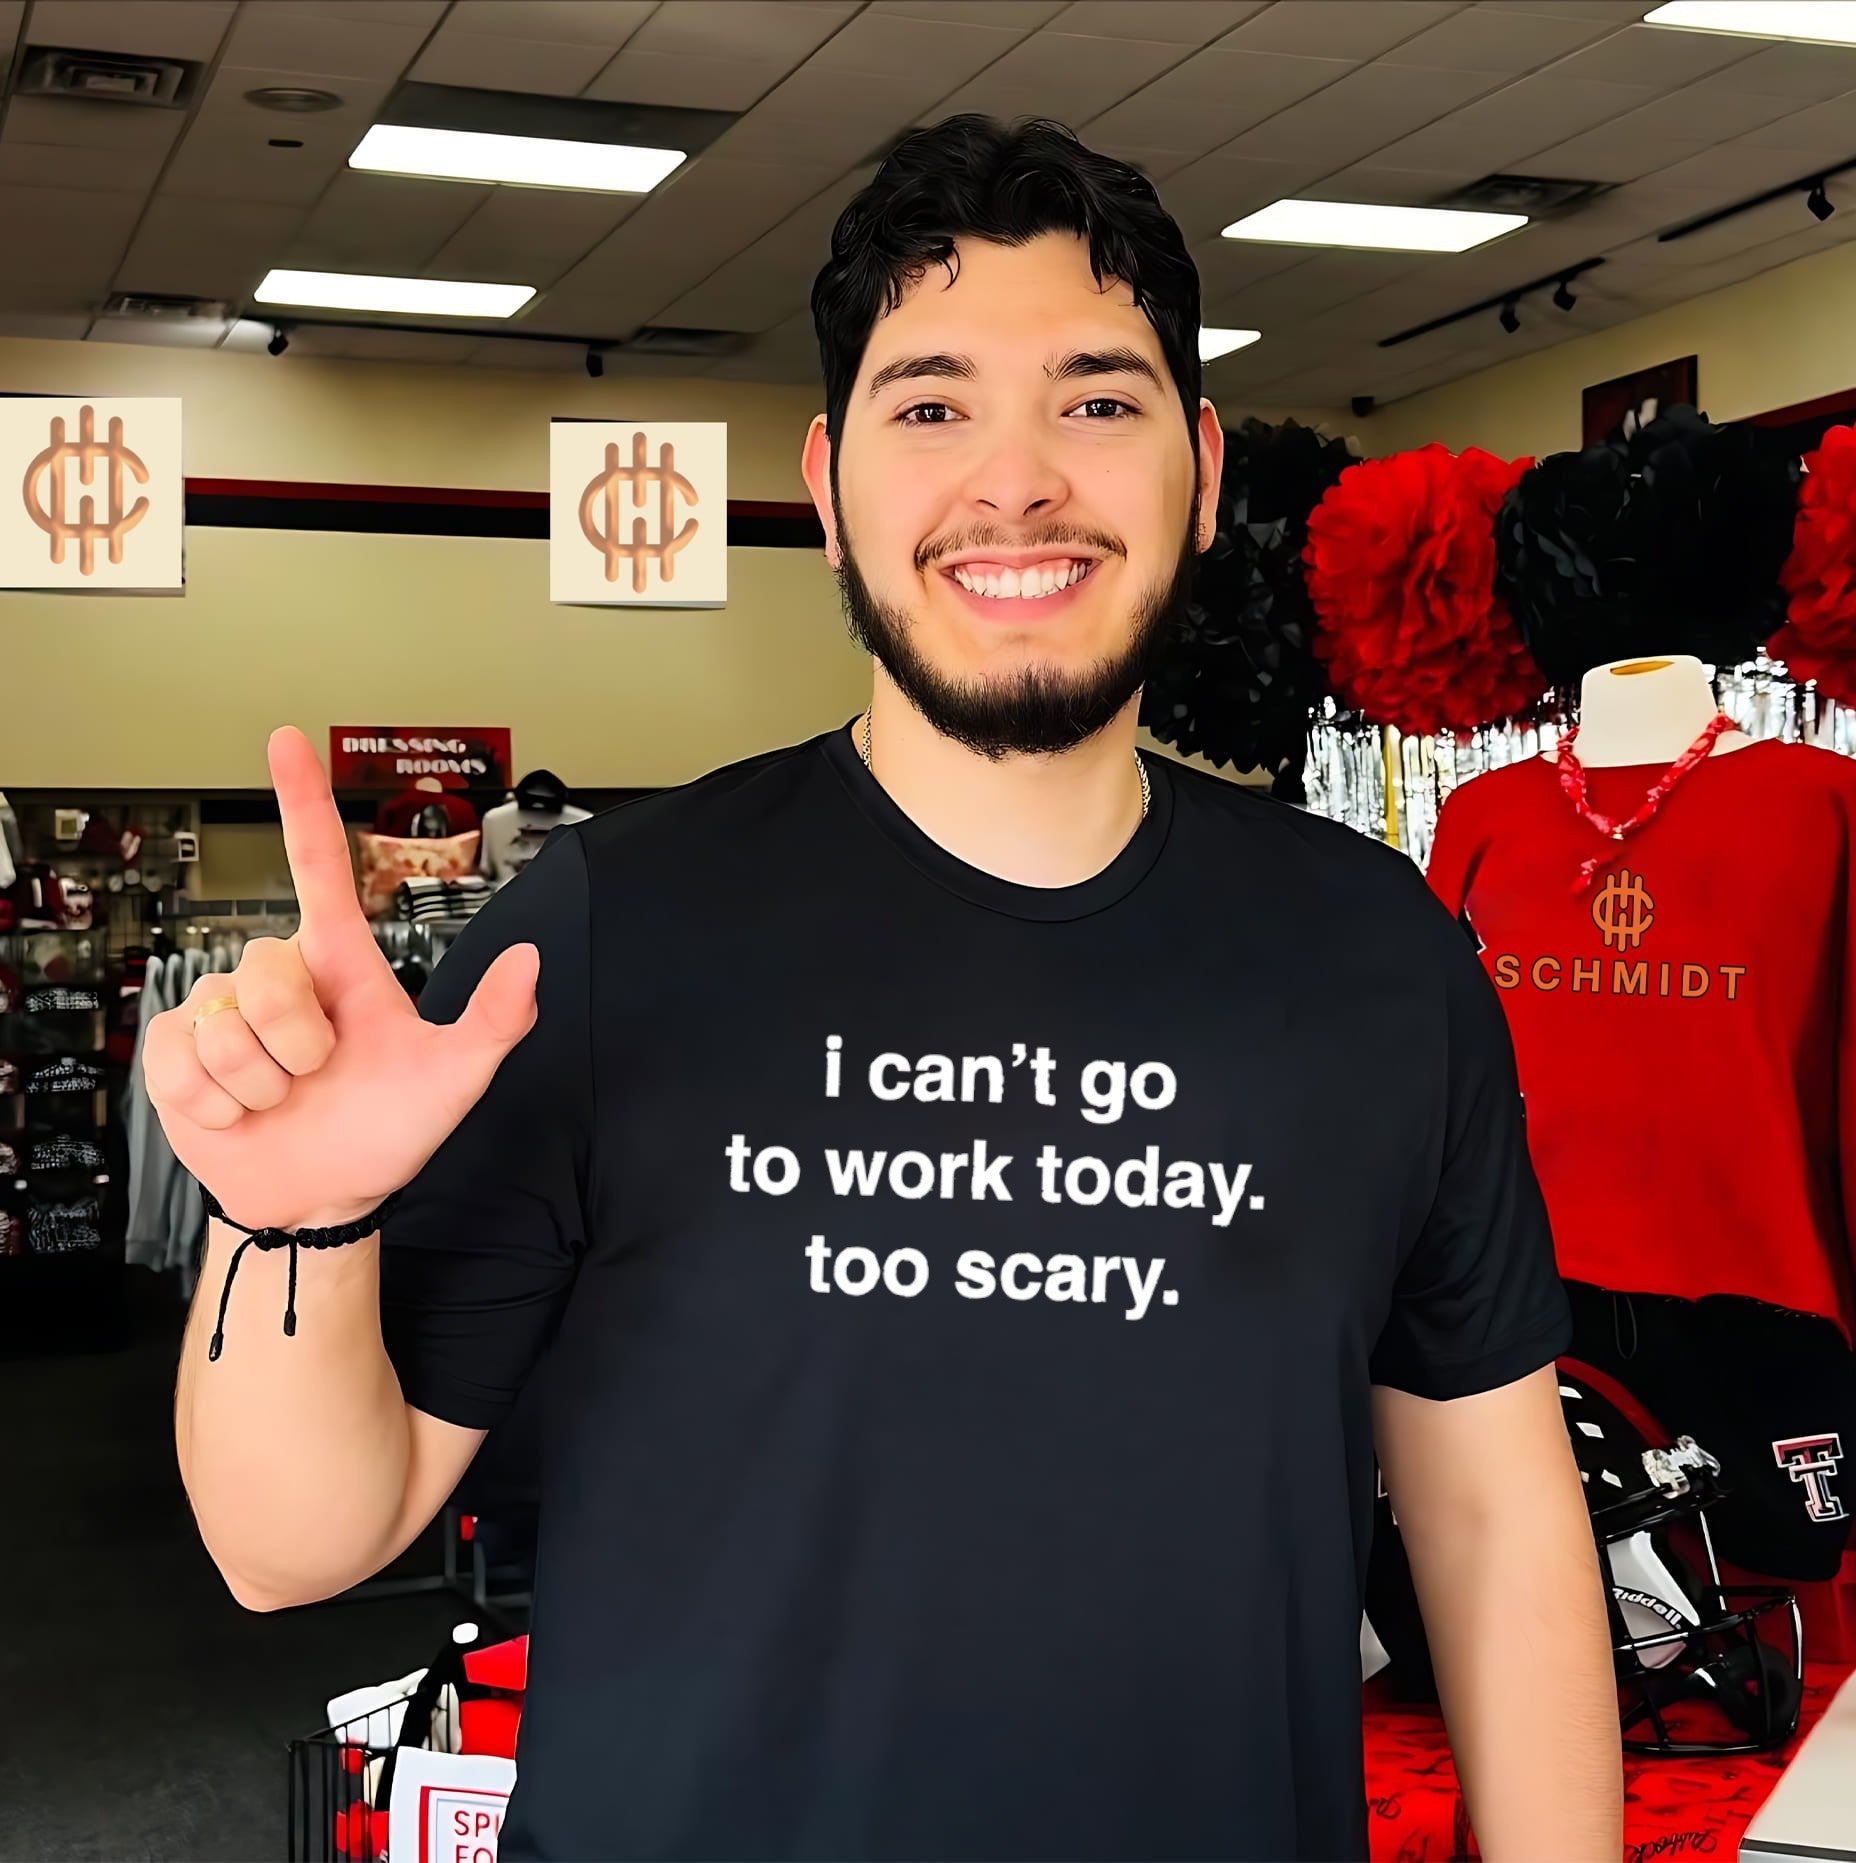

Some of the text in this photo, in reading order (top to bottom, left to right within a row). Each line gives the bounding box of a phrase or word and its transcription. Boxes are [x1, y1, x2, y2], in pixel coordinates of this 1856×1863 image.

[1494, 954, 1747, 1000] SCHMIDT
[825, 1034, 1178, 1125] i can’t go
[725, 1133, 1265, 1228] to work today.
[804, 1234, 1179, 1321] too scary.
